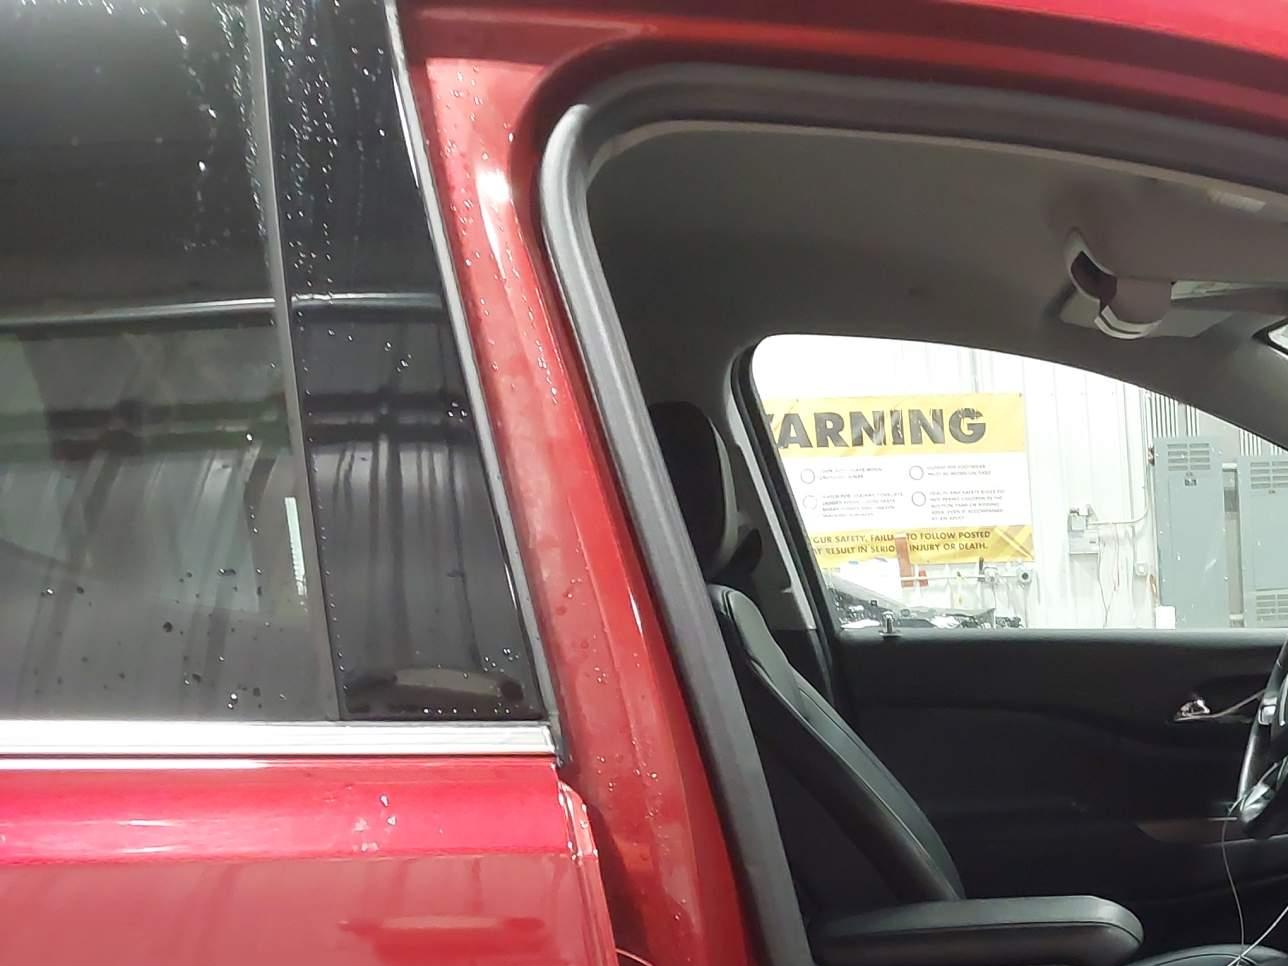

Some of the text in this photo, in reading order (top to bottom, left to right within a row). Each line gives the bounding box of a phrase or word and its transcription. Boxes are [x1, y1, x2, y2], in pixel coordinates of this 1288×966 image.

[811, 535, 832, 545] OUR
[906, 532, 918, 541] TO
[920, 532, 955, 540] FOLLOW
[958, 531, 991, 539] POSTED
[825, 546, 855, 555] RESULT
[858, 545, 868, 553] IN
[870, 544, 896, 553] SERIO
[909, 543, 940, 552] INJURY
[943, 543, 956, 551] OR
